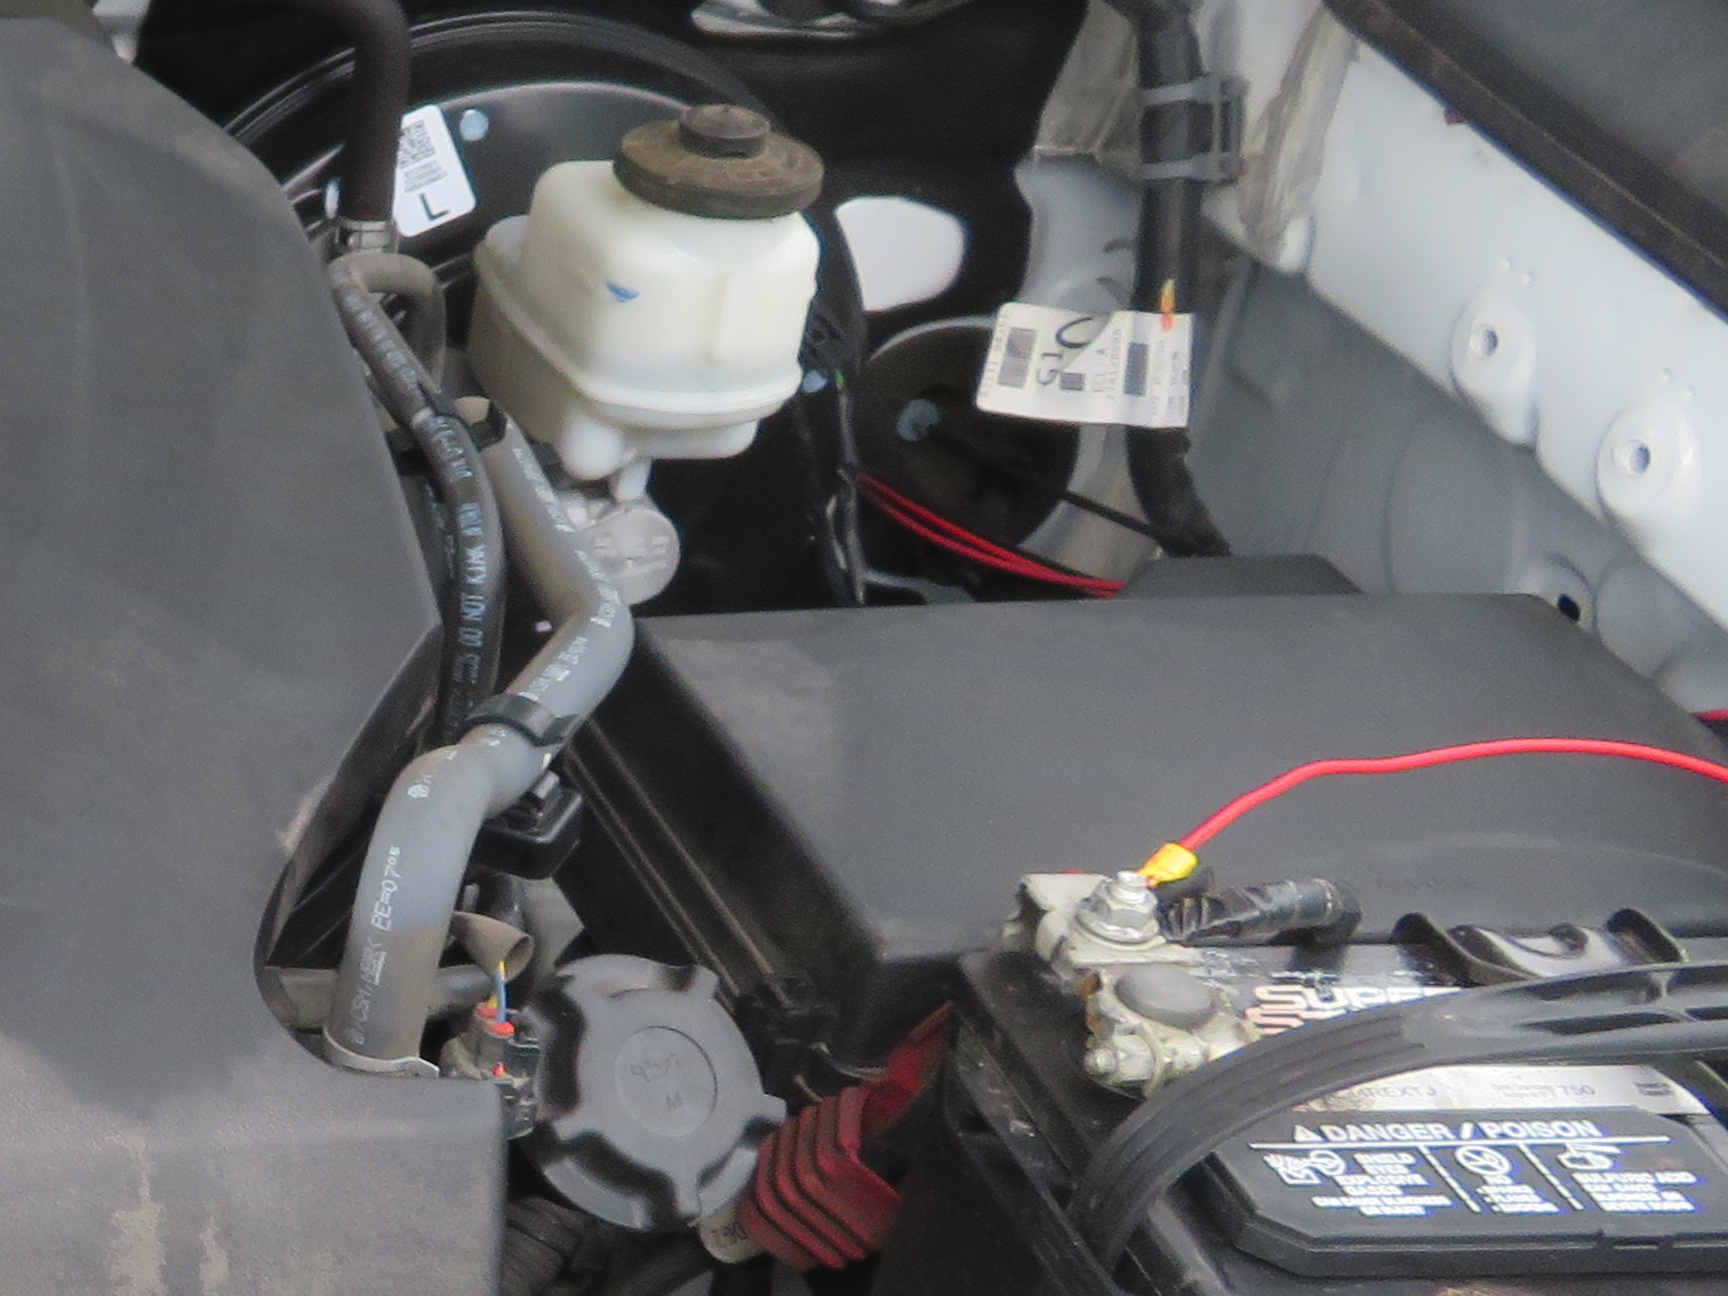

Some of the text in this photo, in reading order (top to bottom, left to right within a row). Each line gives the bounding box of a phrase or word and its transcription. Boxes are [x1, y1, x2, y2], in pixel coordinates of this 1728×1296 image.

[418, 192, 451, 222] L
[1319, 1122, 1457, 1142] DANGER
[1478, 1119, 1604, 1139] POISON
